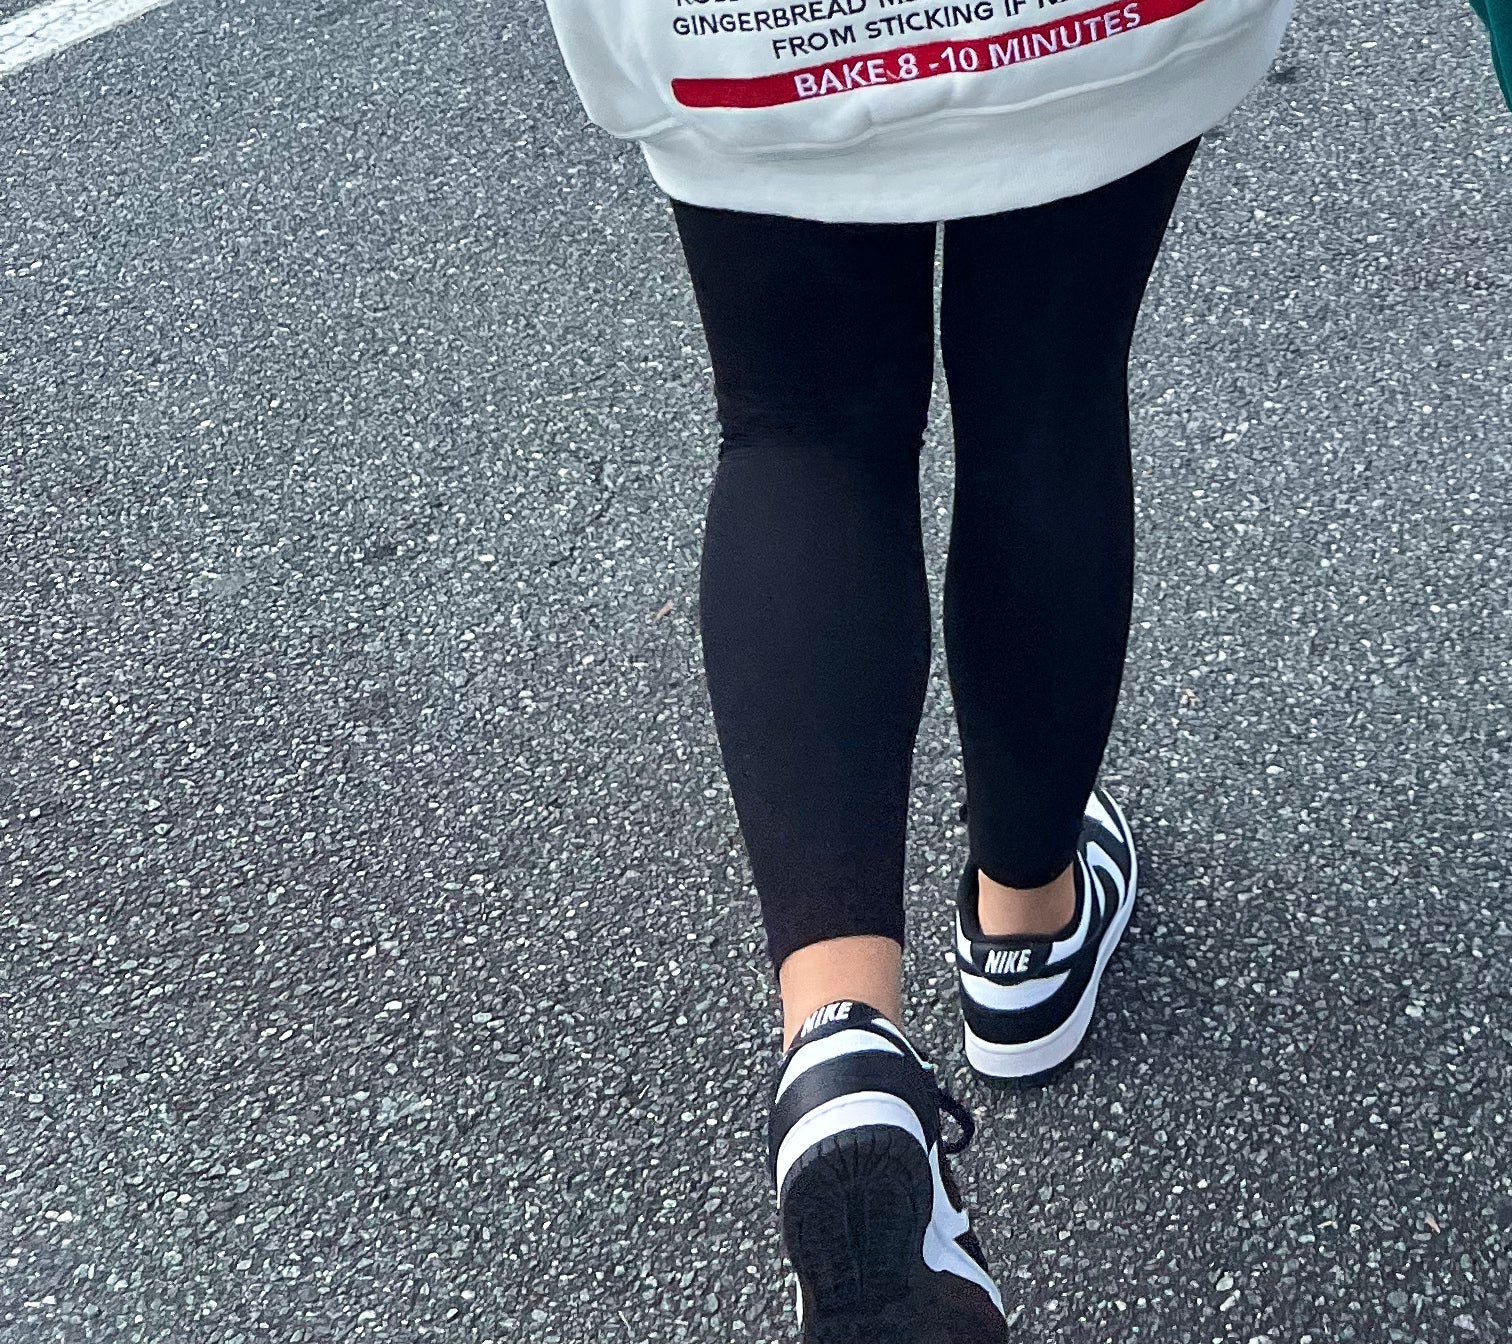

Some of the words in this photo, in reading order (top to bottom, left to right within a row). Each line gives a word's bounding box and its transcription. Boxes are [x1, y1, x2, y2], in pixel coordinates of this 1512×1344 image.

[772, 25, 857, 59] FROM
[865, 1, 994, 39] STICKING
[793, 58, 888, 98] BAKE
[897, 52, 920, 80] 8
[987, 2, 1142, 69] MINUTES
[984, 949, 1032, 974] NIKE
[800, 1001, 854, 1039] NIKE
